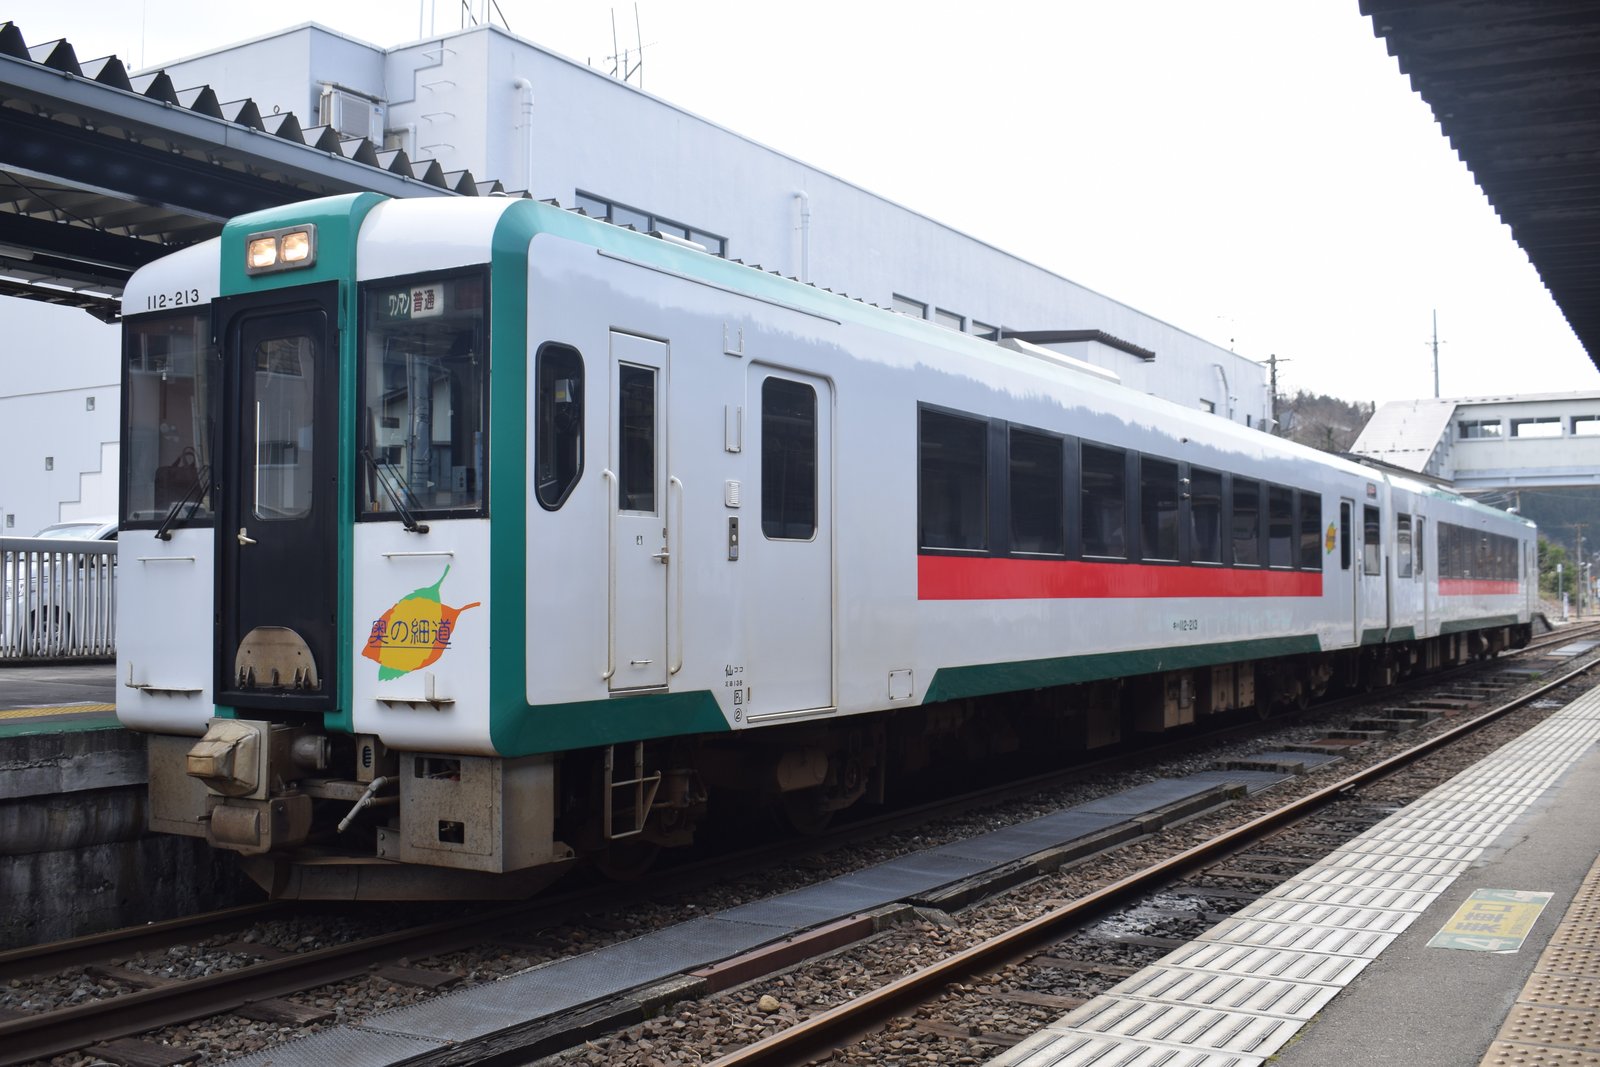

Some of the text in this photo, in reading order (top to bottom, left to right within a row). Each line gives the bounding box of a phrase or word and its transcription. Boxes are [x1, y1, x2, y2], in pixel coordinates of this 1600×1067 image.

[148, 289, 199, 310] 112-213
[413, 290, 435, 312] 普通
[370, 618, 452, 645] 奥の細道
